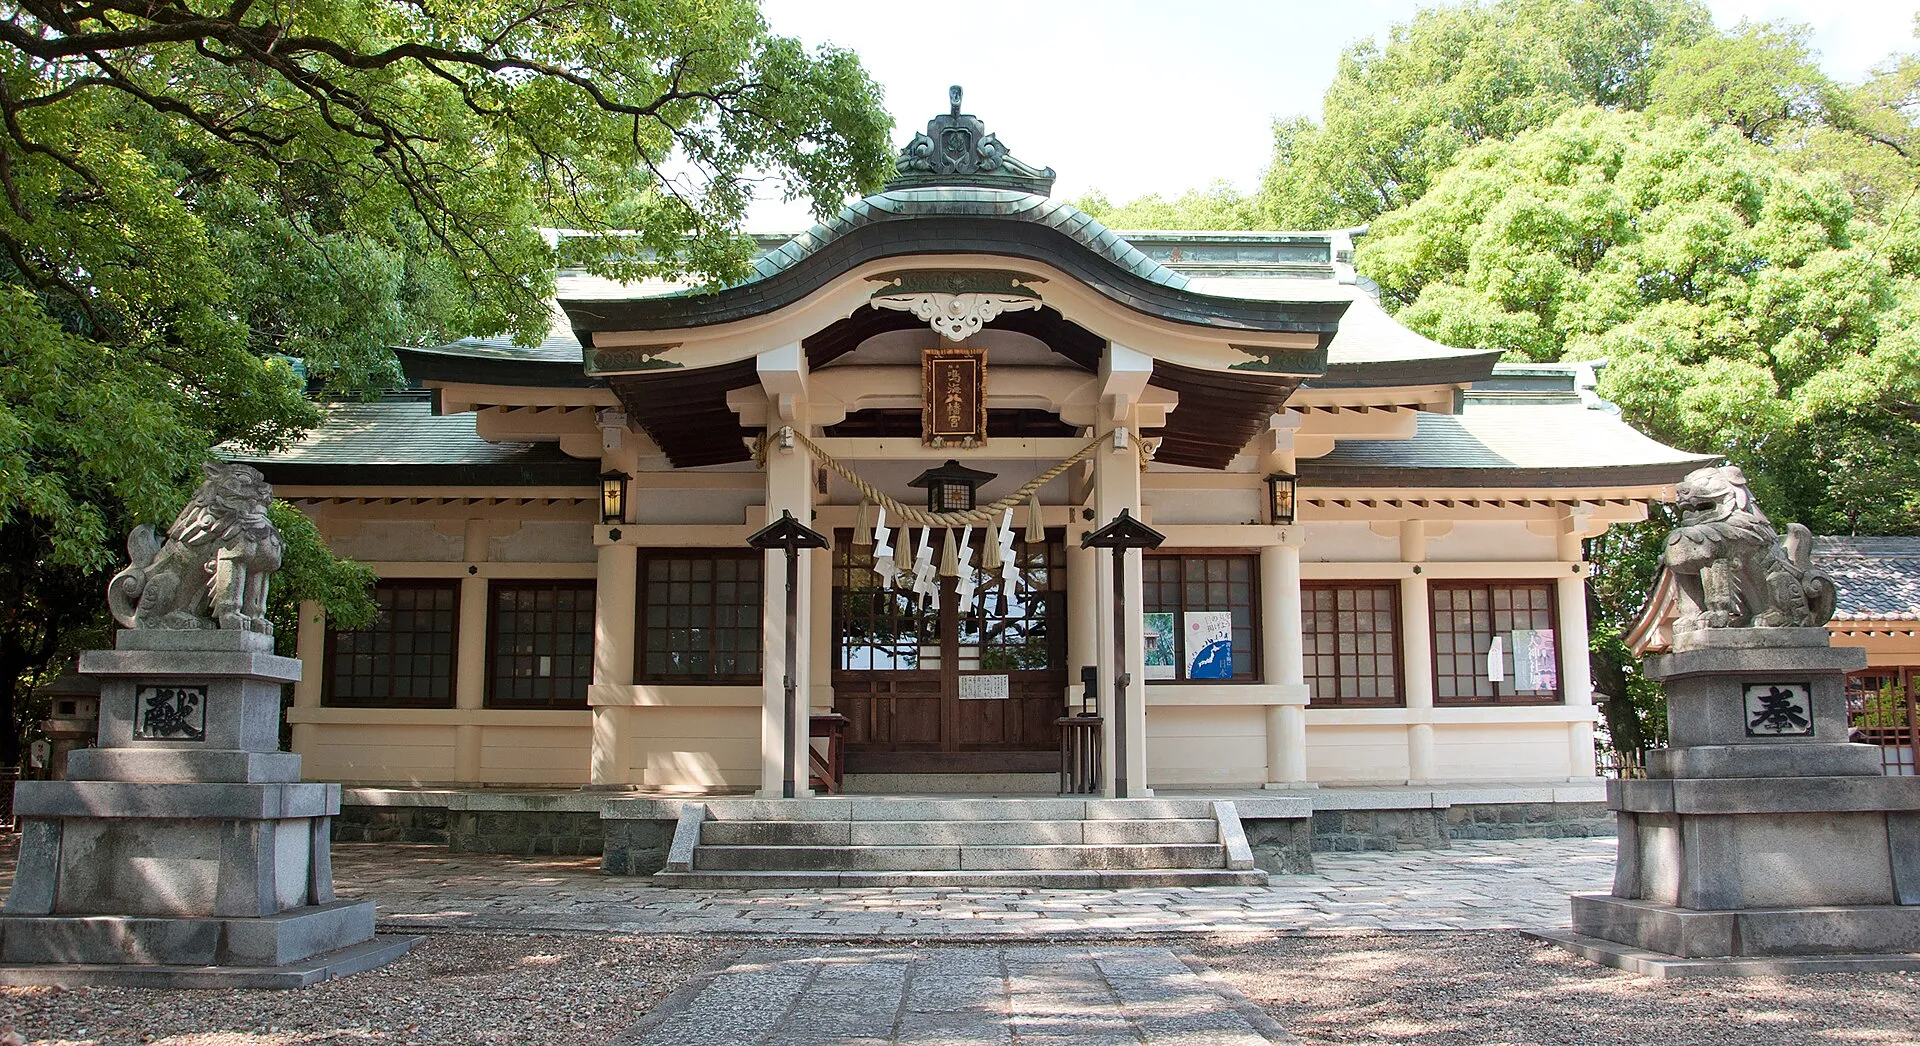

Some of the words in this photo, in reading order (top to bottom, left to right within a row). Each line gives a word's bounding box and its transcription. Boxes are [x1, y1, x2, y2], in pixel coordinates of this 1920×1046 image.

[1219, 658, 1228, 677] 日本
[143, 686, 201, 737] 献
[1750, 686, 1809, 733] 奉
